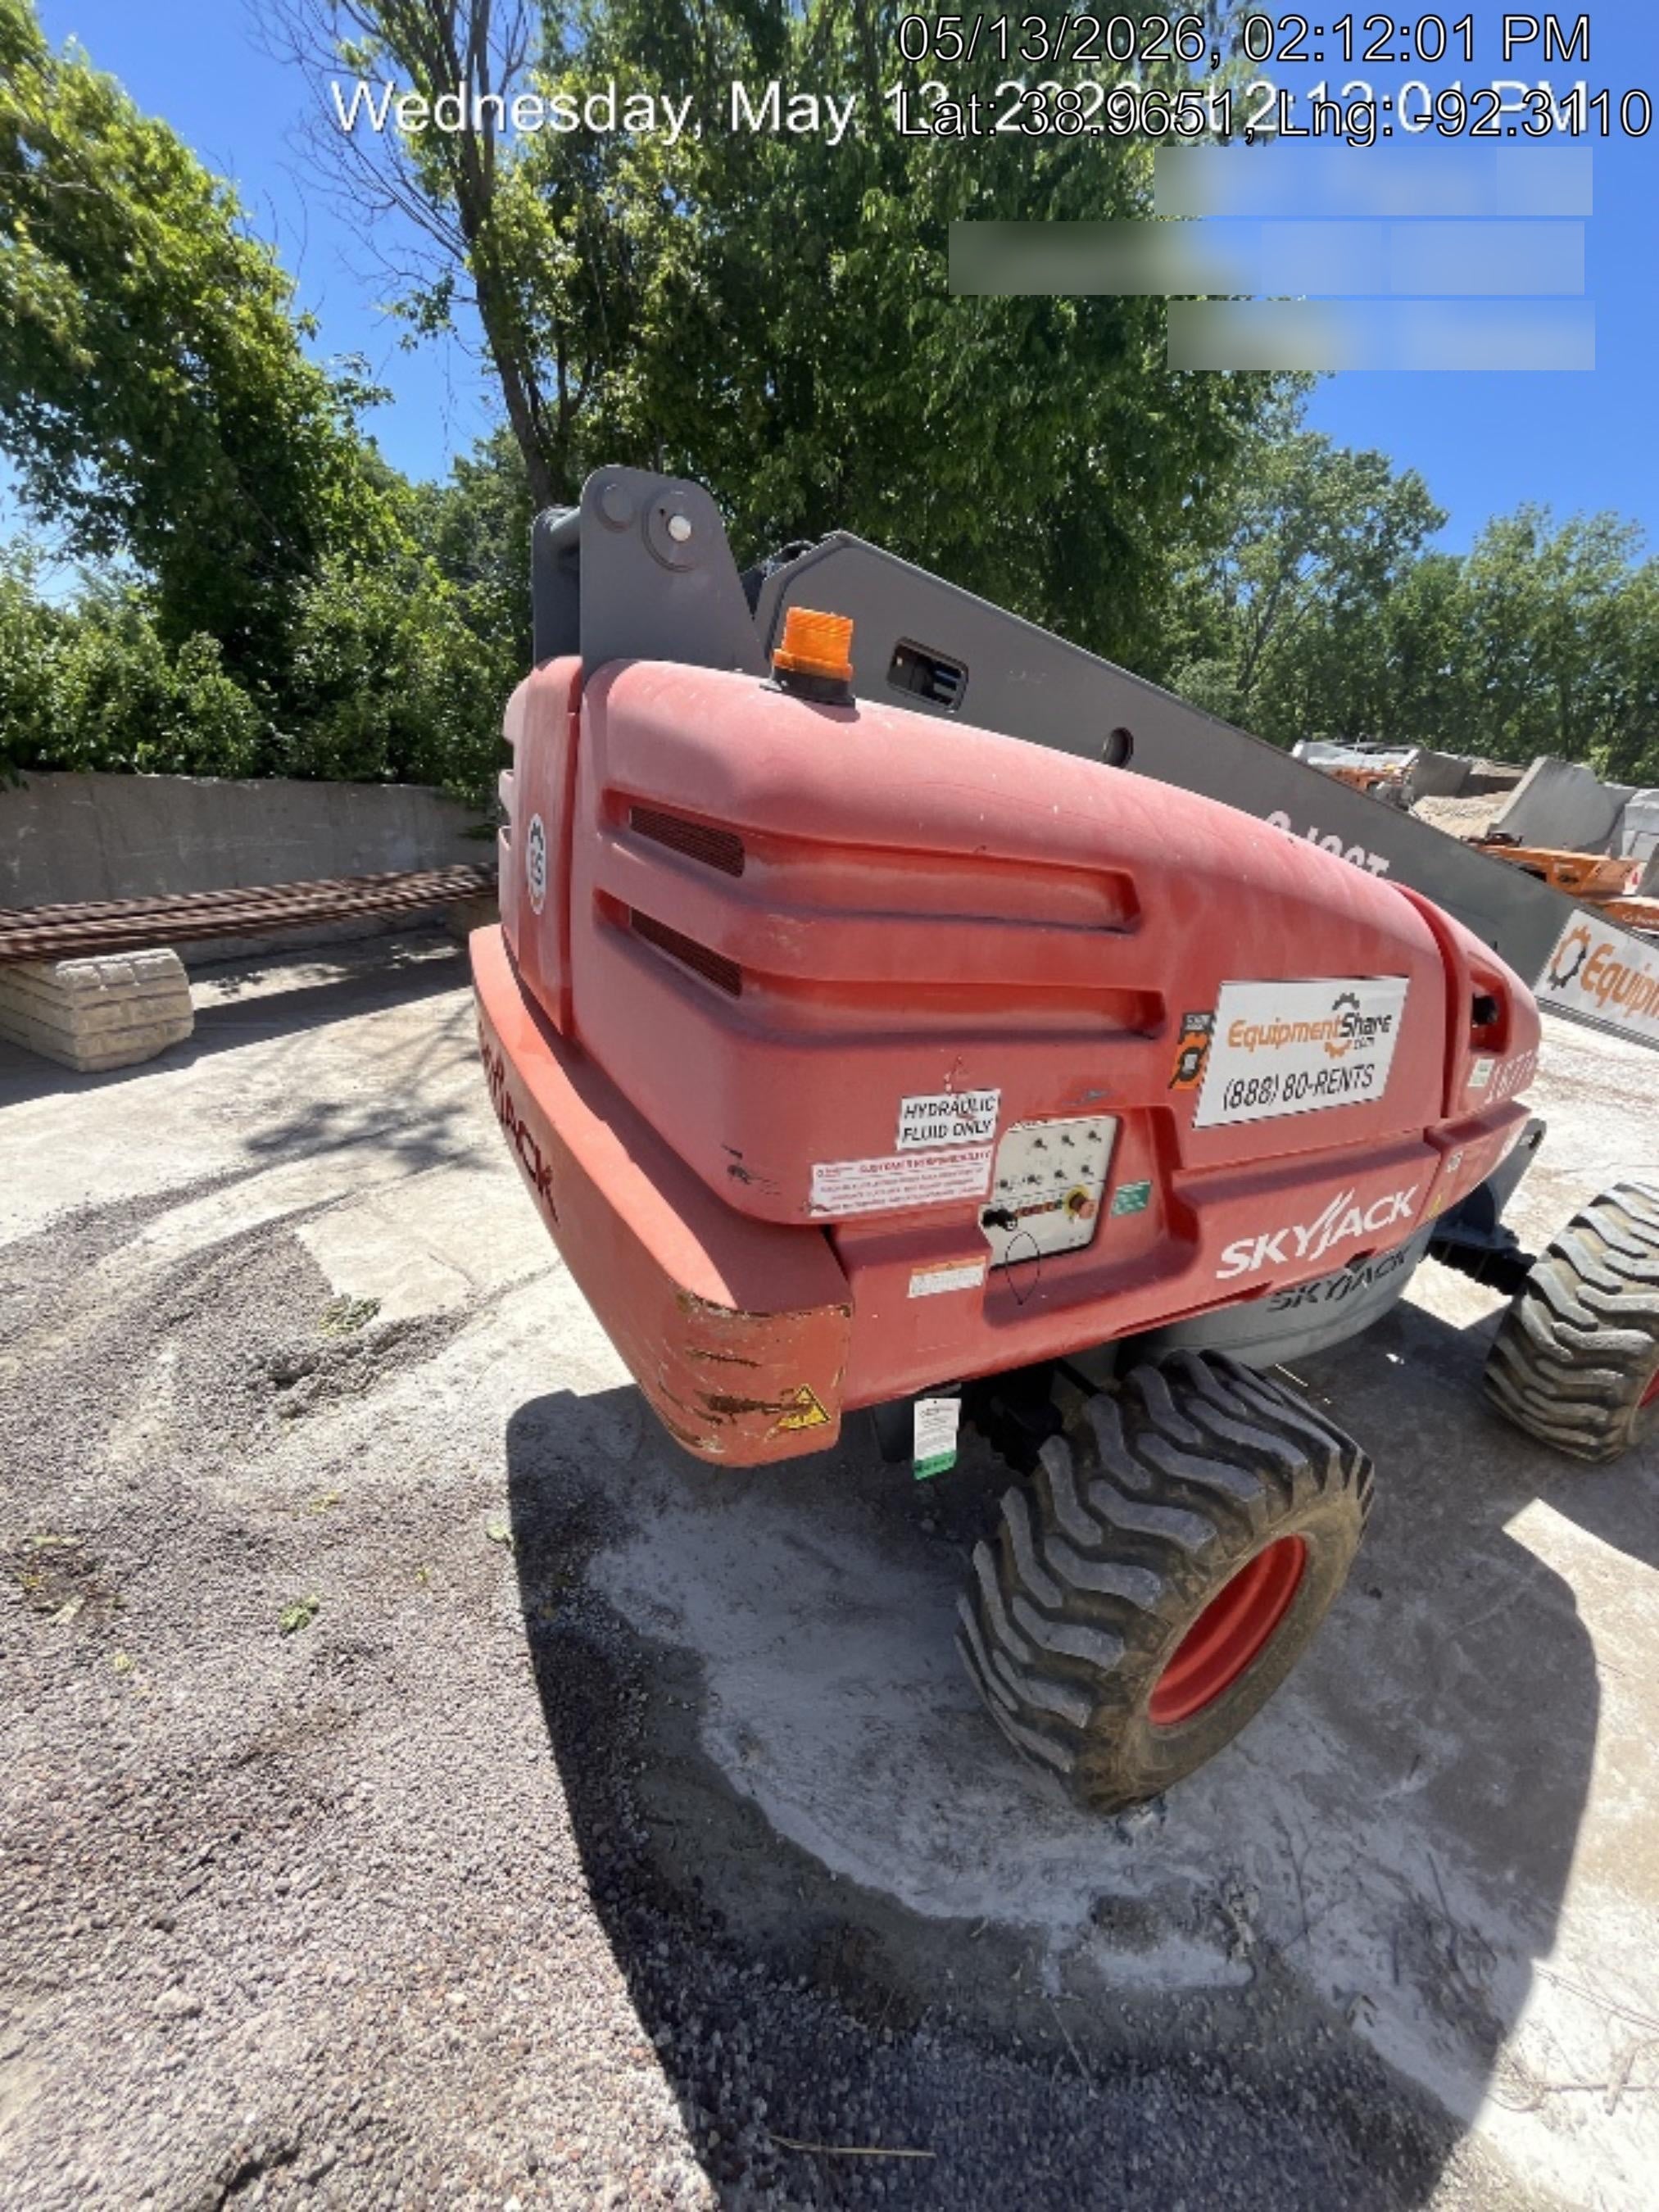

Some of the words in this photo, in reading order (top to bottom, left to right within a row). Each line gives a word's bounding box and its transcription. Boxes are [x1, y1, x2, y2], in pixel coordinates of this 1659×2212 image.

[1228, 1011, 1393, 1054] EquipmentShare
[904, 1095, 996, 1119] HYDRAULIC
[1222, 1075, 1280, 1111] (888)
[1283, 1063, 1375, 1104] 80-RENTS
[902, 1124, 948, 1143] FLUID
[952, 1118, 994, 1137] ONLY
[1216, 1185, 1419, 1280] SKYJACK
